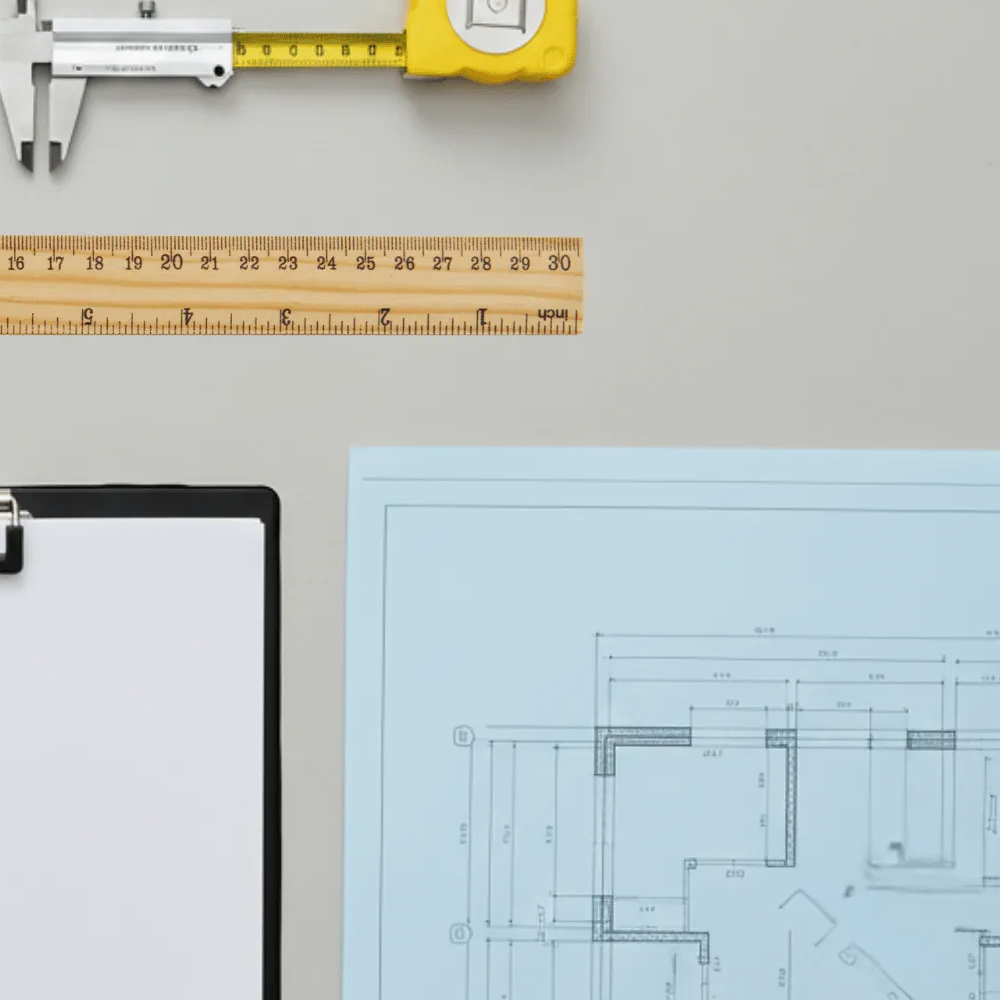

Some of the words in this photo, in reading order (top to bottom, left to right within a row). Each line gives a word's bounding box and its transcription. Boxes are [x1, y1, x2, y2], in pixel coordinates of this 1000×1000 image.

[7, 255, 25, 270] 16
[47, 255, 64, 270] 17
[86, 255, 104, 270] 18
[125, 255, 143, 270] 19
[160, 254, 184, 270] 20
[201, 255, 219, 270] 21
[239, 255, 260, 270] 22
[278, 255, 298, 270] 23
[316, 255, 337, 270] 24
[356, 255, 376, 270] 25
[394, 255, 415, 270] 26
[433, 255, 453, 270] 27
[471, 255, 492, 270] 28
[510, 255, 530, 270] 29
[548, 255, 571, 271] 30
[83, 307, 94, 326] 5
[183, 307, 194, 326] 4
[281, 307, 292, 326] 3
[380, 307, 391, 326] 2
[478, 307, 488, 326] 1
[537, 308, 569, 321] inch
